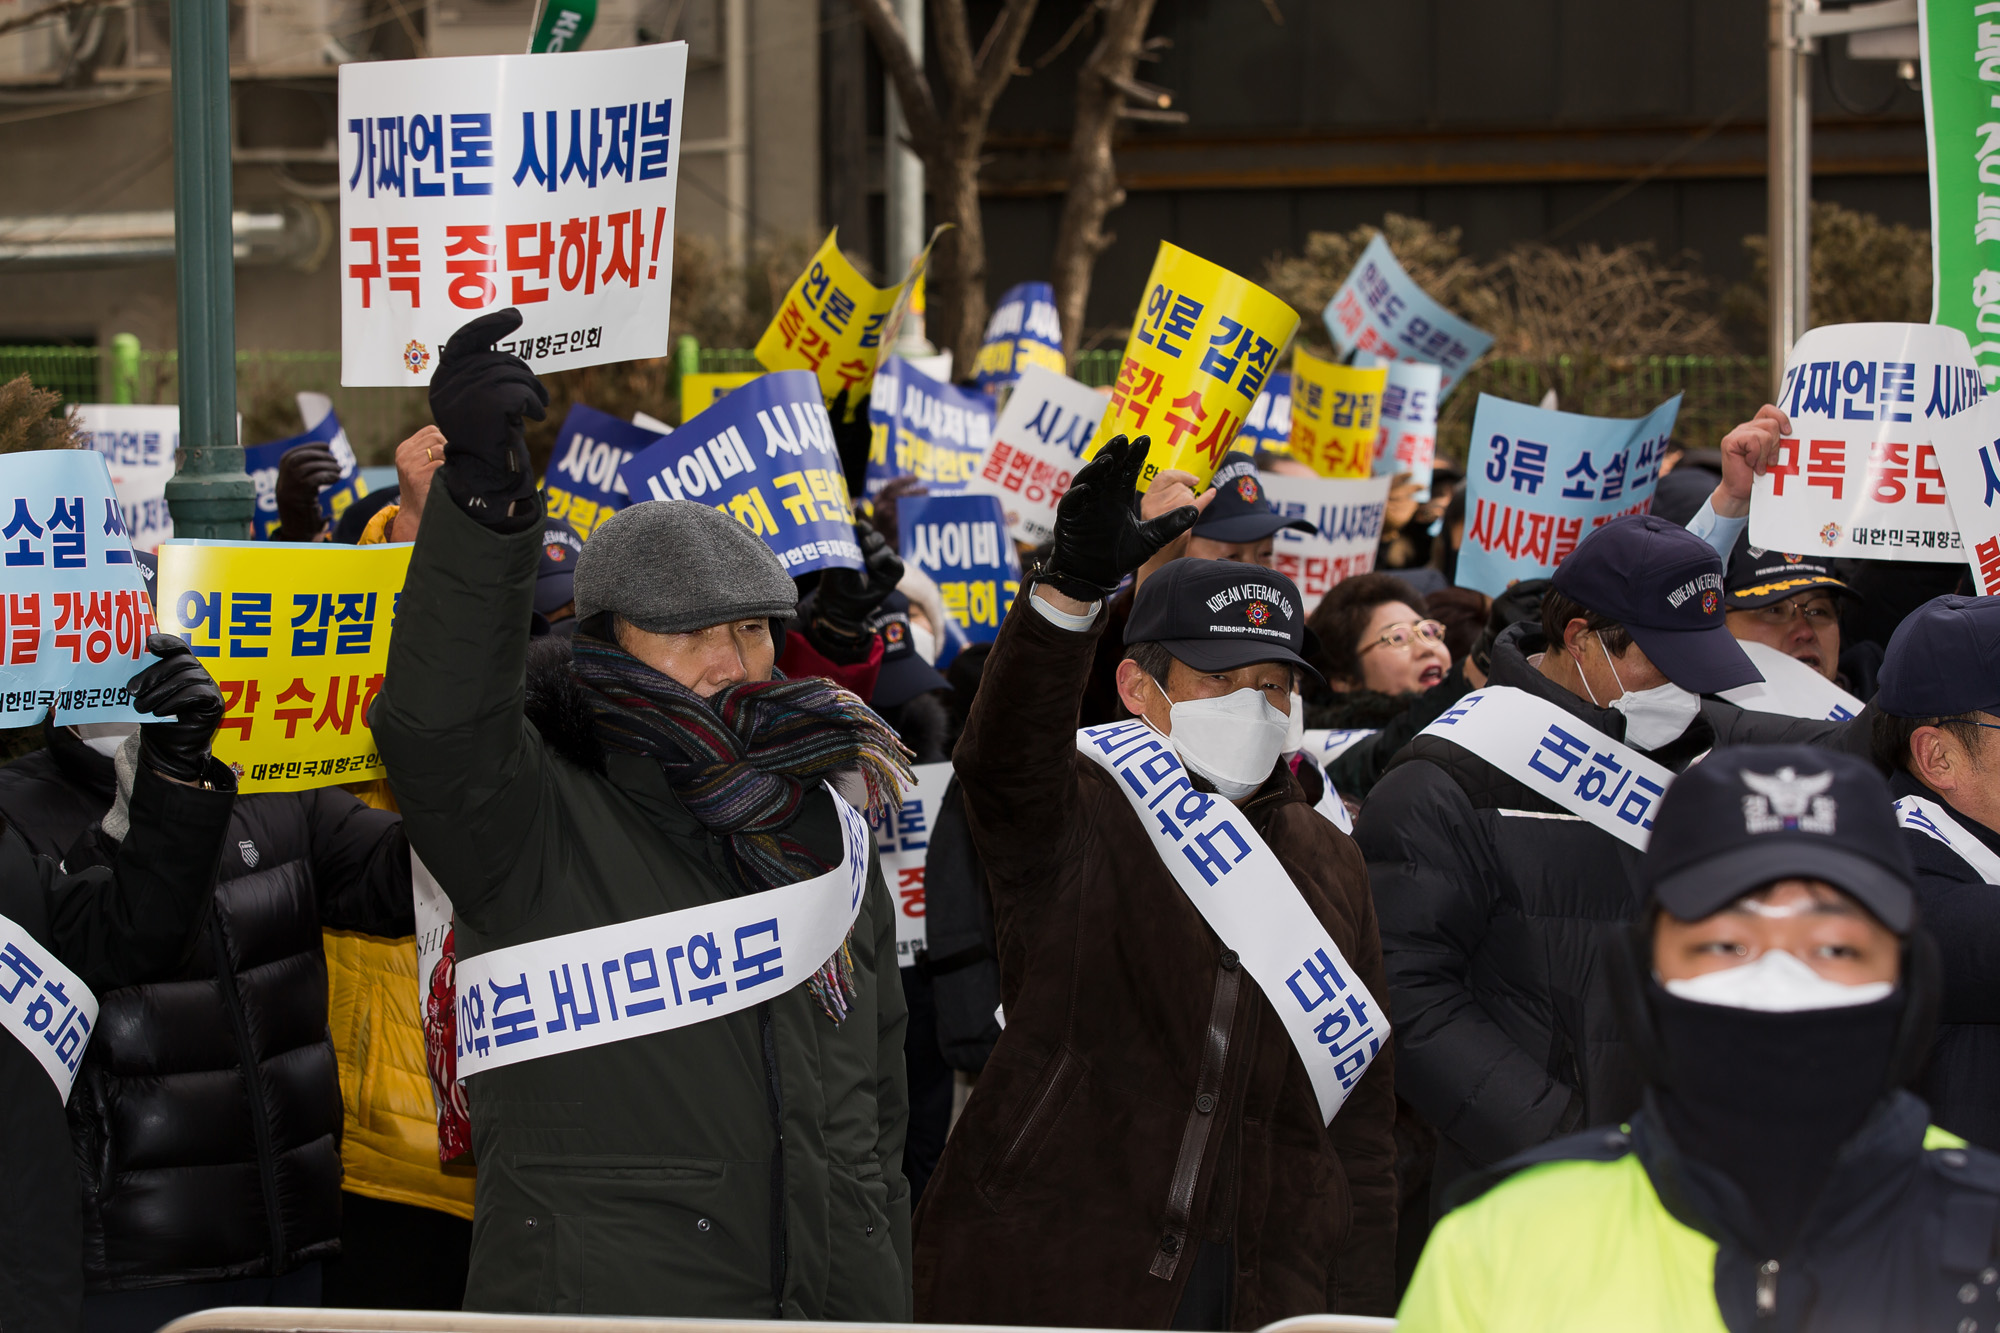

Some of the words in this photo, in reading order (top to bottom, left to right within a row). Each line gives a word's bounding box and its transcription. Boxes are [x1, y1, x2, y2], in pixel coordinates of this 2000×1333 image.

[348, 113, 494, 199] 가짜언론
[513, 98, 672, 193] 시사저널
[349, 226, 421, 309] 구독
[445, 207, 666, 310] 중단하자!
[801, 261, 857, 335] 언론
[778, 300, 831, 373] 즉각
[1138, 283, 1205, 359] 언론
[1199, 315, 1279, 402] 갑질
[1111, 357, 1165, 430] 즉각
[1778, 360, 1916, 423] 가짜언론
[647, 425, 757, 500] 사이비
[1486, 434, 1548, 496] 3류
[1562, 448, 1629, 502] 소설
[1765, 438, 1846, 500] 구독
[2, 497, 87, 569] 소설
[909, 521, 1001, 571] 사이비
[1469, 498, 1584, 567] 시사저널
[1852, 527, 1965, 550] 대한민국재향군
[0, 592, 41, 666] 널
[176, 590, 273, 659] 언론
[291, 592, 378, 658] 갑질
[1205, 586, 1242, 613] KOREAN
[1240, 583, 1282, 606] VETERANS
[1279, 597, 1294, 621] ASSN
[1666, 580, 1697, 609] KOREAN
[456, 917, 785, 1058] 대한민국재향
[1285, 947, 1380, 1099] 대한민
